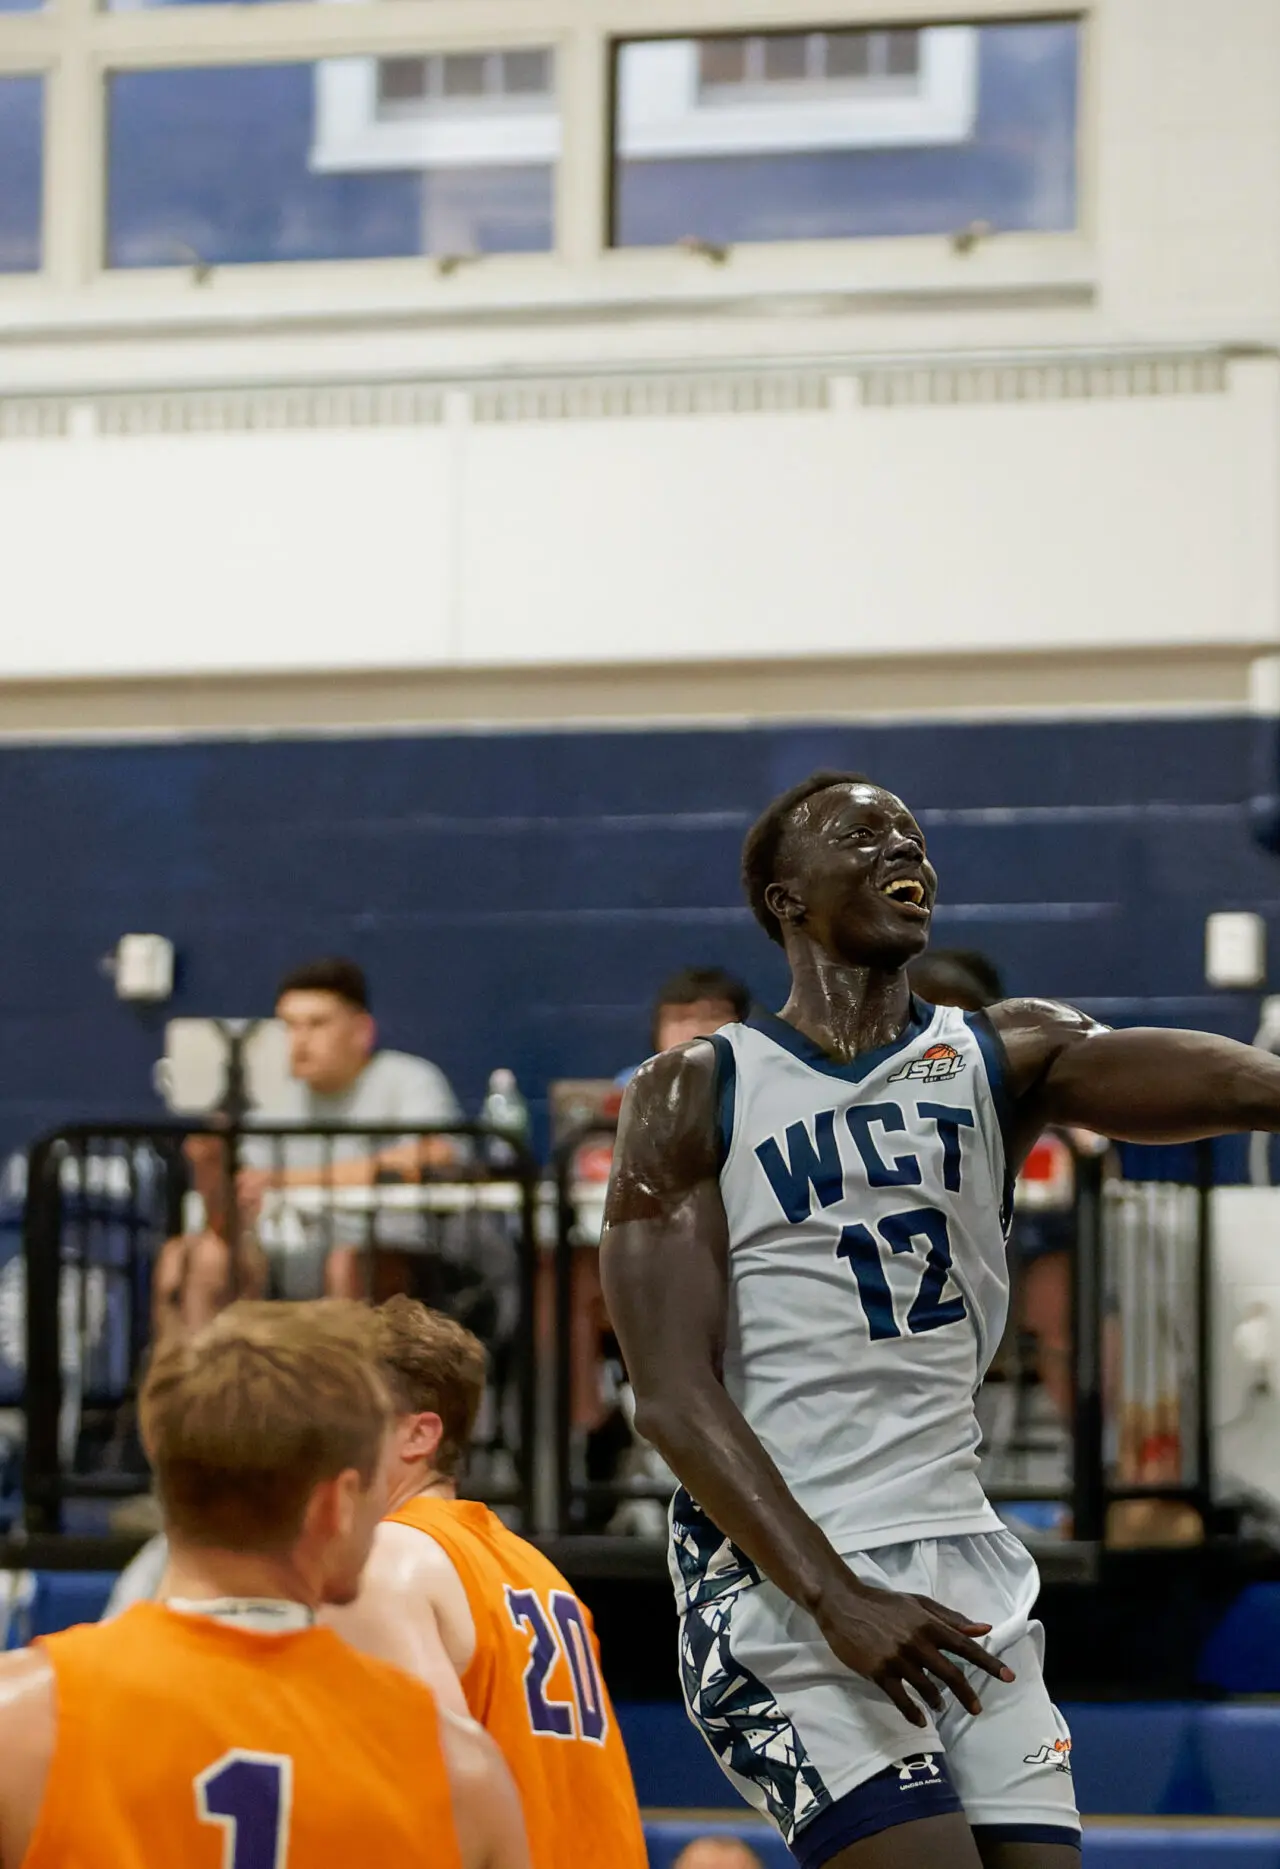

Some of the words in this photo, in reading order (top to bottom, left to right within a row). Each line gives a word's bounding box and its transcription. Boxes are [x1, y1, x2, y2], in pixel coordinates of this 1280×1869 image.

[886, 1054, 967, 1083] JSBL
[753, 1101, 975, 1225] WCT
[835, 1206, 968, 1342] 12
[502, 1585, 608, 1748] 20
[193, 1748, 292, 1869] 1
